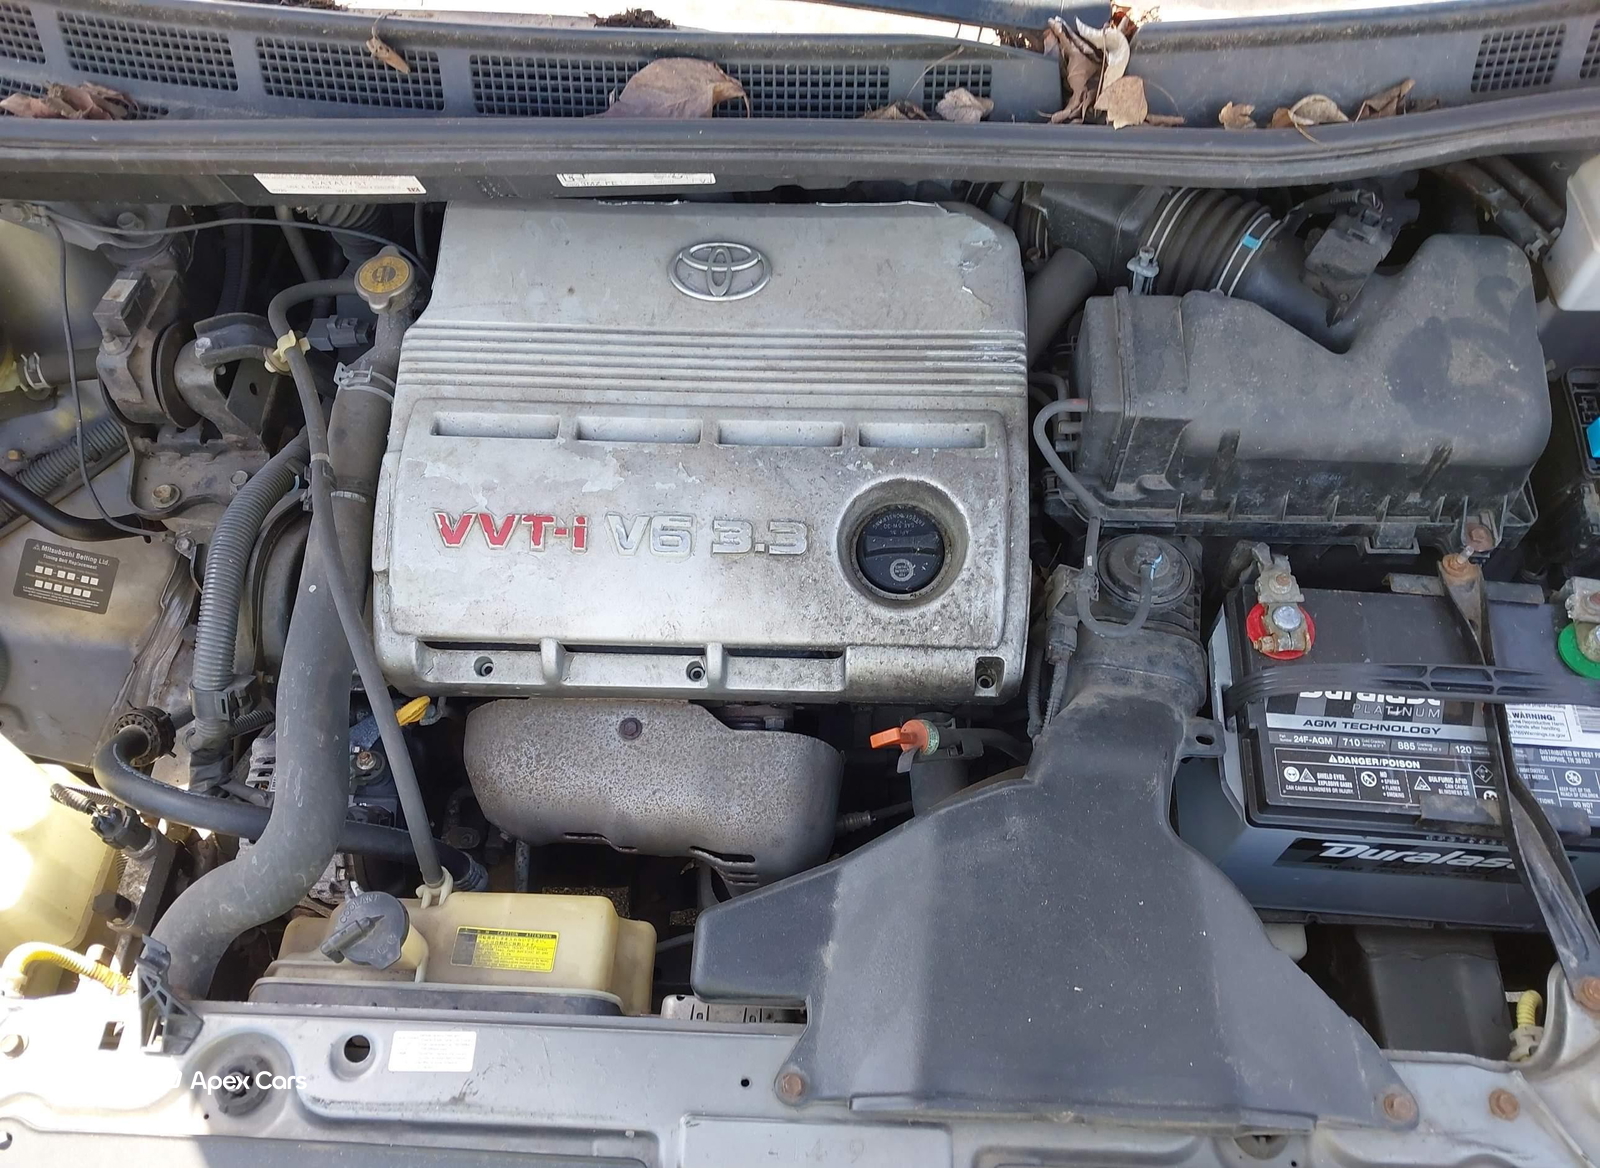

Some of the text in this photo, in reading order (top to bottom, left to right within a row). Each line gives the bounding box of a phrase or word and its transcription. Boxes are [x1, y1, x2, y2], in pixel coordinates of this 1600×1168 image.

[433, 511, 809, 558] VVT-i V6 3.3
[41, 544, 110, 566] Mitsuboshi Belting Ltd.
[1352, 704, 1440, 718] PLATINUM
[1512, 712, 1556, 721] WARNING:
[1303, 719, 1441, 735] AGM TECHNOLOGY
[1293, 735, 1332, 745] 24F-AGM
[1343, 738, 1360, 746] 710
[1398, 742, 1415, 750] 885
[1455, 746, 1472, 754] 120
[1338, 756, 1420, 769] DANGER/POISON
